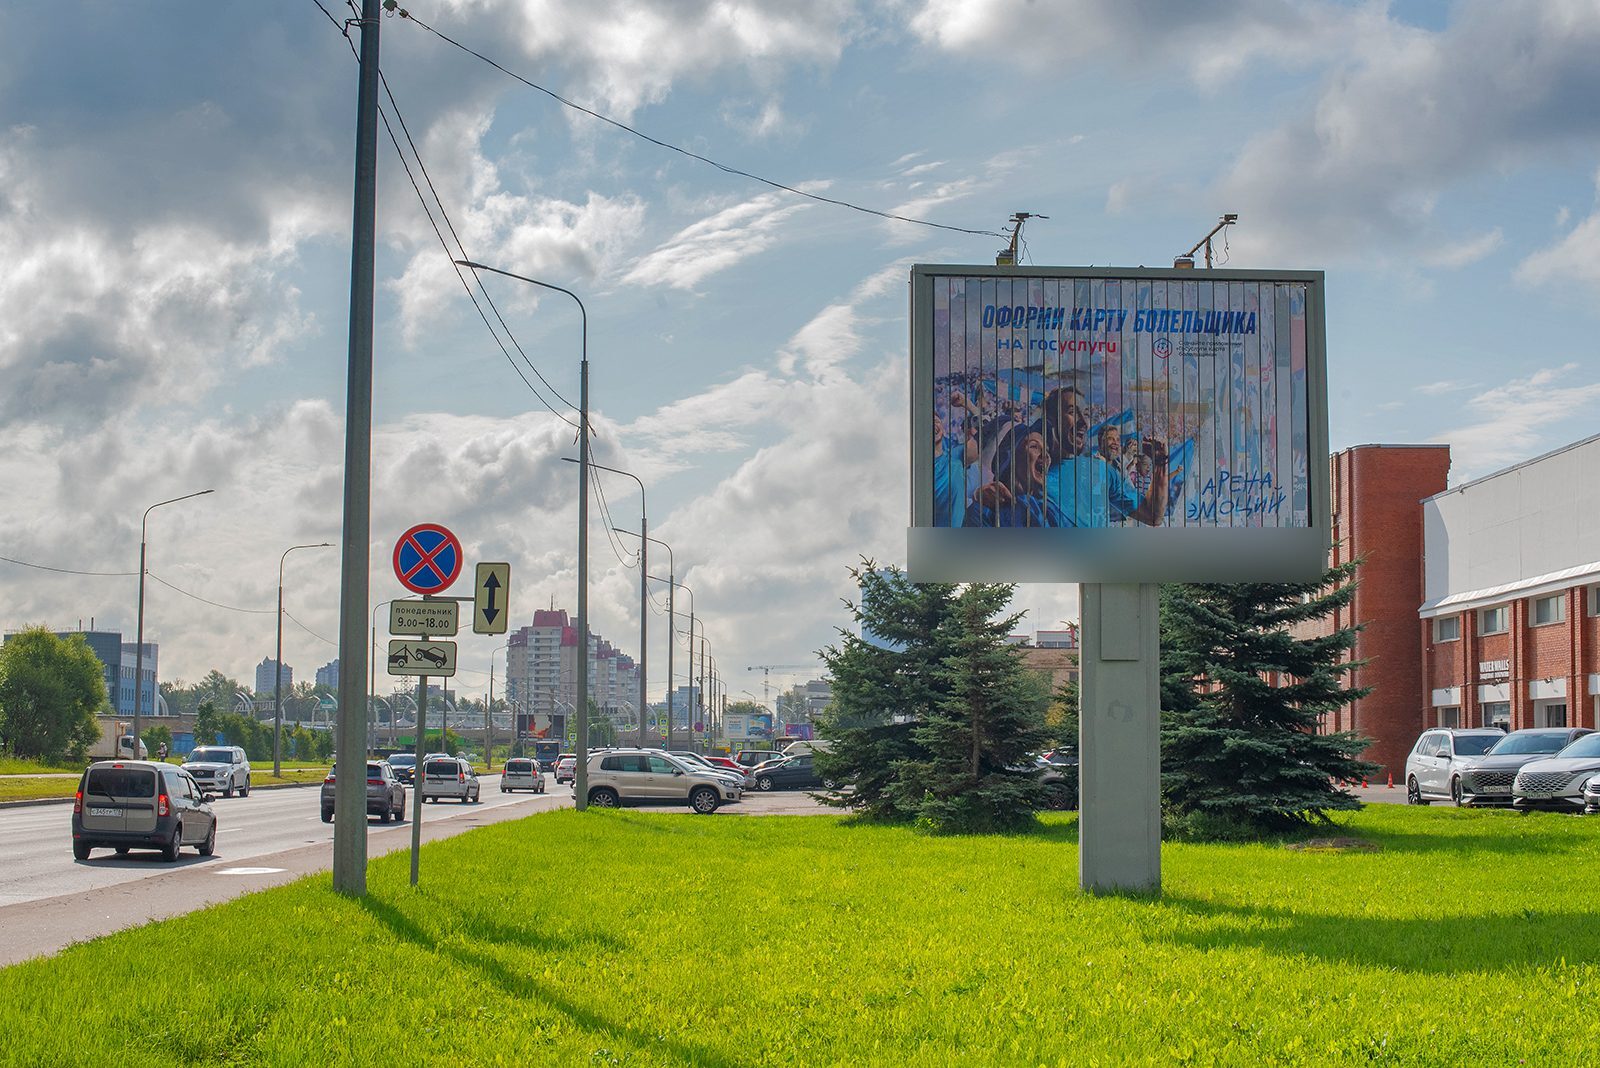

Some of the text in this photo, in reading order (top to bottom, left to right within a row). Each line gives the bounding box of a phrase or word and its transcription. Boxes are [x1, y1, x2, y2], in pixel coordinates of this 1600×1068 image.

[982, 304, 1256, 336] ОФОРМИ КАРТУ БОЛЕЛЬЩИКА
[998, 339, 1023, 349] НА
[1201, 470, 1273, 498] АРЕНА
[1187, 486, 1286, 520] ЭМОЦИЙ
[395, 607, 453, 615] понедельник
